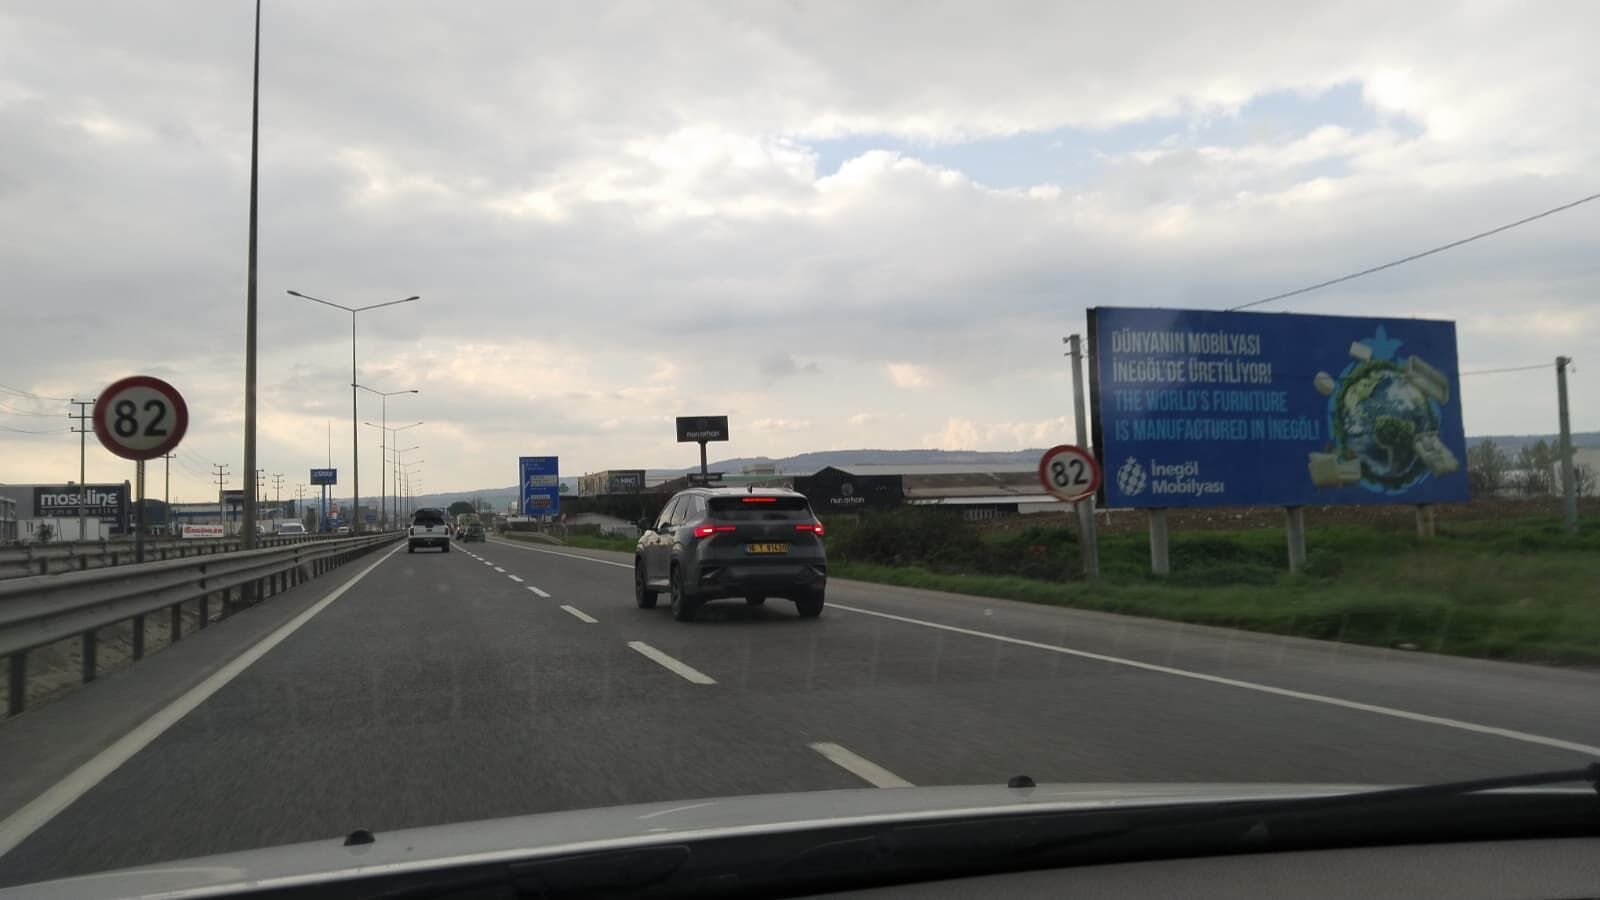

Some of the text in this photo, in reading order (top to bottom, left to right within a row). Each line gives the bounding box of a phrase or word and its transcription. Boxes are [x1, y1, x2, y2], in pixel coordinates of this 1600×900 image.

[1112, 328, 1260, 355] DÜNYANIN MOBİLYASI
[1113, 357, 1272, 384] İNEGÖL'DE ÜRETİLİYOR!
[1116, 389, 1288, 412] THE WORLD'S FURNITURE
[114, 399, 167, 438] 82
[1116, 416, 1320, 441] IS MANUFACTURED IN İNEGÖL!
[1051, 458, 1089, 488] 82
[1151, 459, 1199, 479] İnegöl
[1152, 478, 1225, 496] Mobilyası
